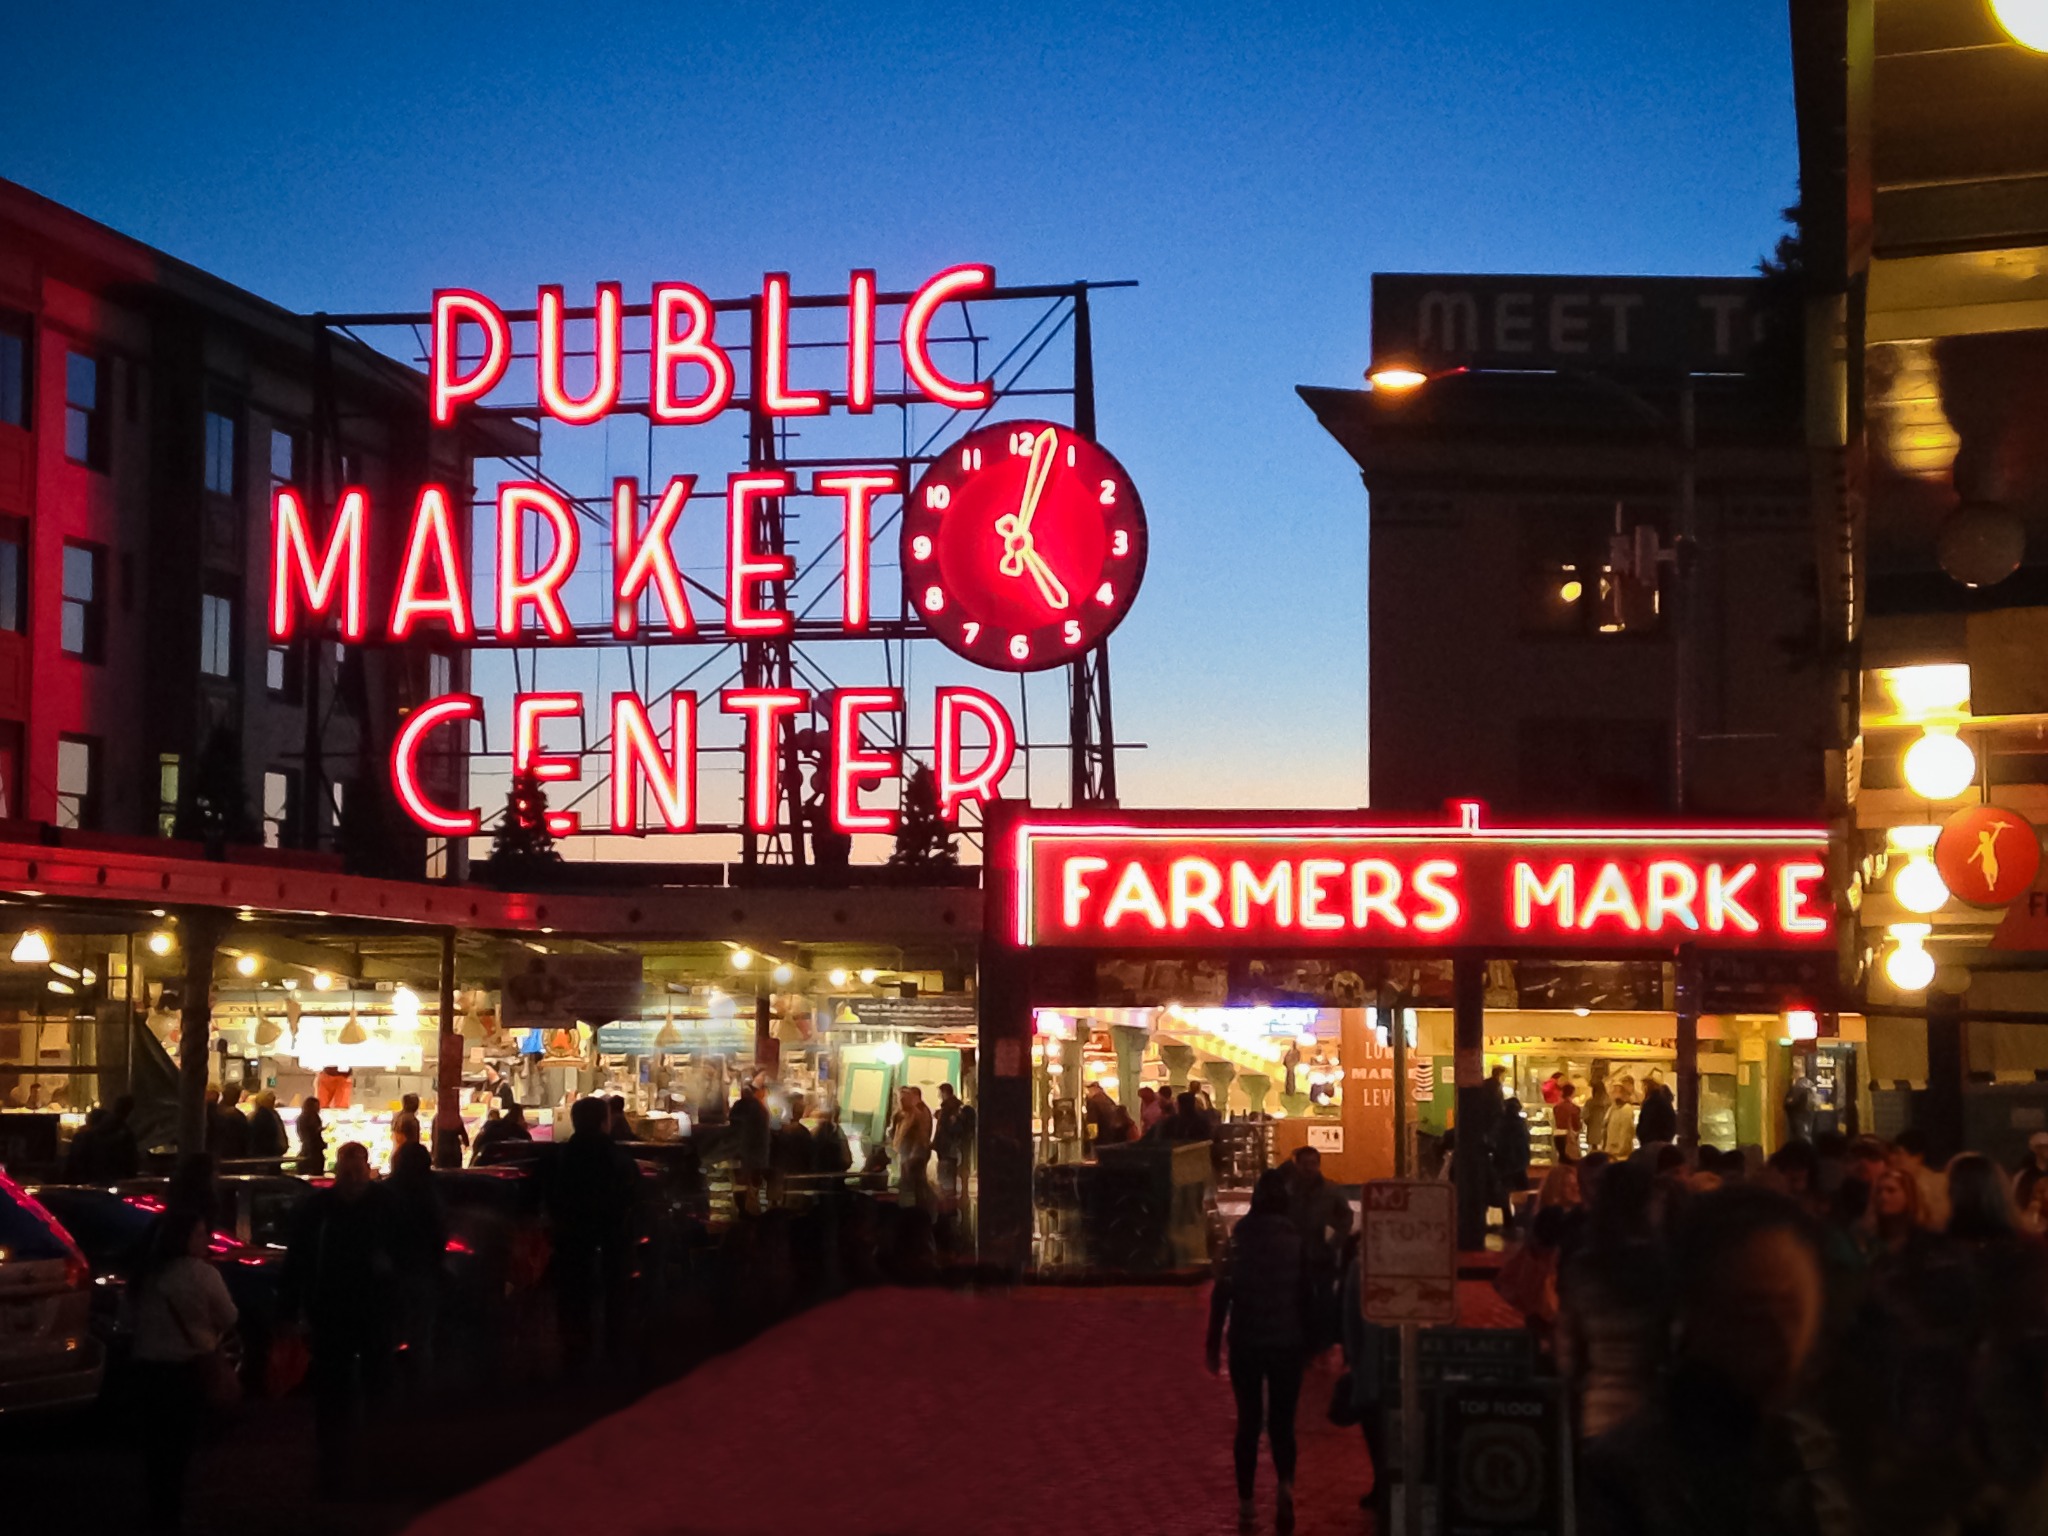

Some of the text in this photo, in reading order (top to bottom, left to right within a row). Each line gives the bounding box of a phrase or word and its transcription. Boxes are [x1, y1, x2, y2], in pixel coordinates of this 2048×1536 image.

[1418, 289, 1643, 354] MEET
[431, 264, 995, 426] PUBLIC
[1009, 431, 1036, 457] 12
[1066, 445, 1077, 468] 1
[961, 448, 982, 471] 11
[926, 484, 950, 510] 10
[1099, 479, 1117, 505] 2
[267, 468, 903, 641] MARKET
[912, 535, 932, 561] 9
[1112, 529, 1129, 557] 3
[925, 586, 945, 612] 8
[1096, 581, 1114, 607] 4
[962, 621, 980, 645] 7
[1064, 619, 1082, 645] 5
[1009, 634, 1030, 660] 6
[391, 686, 1015, 833] CENTER
[1061, 856, 1461, 932] FARMERS
[1459, 1400, 1543, 1417] TOP FLOOR
